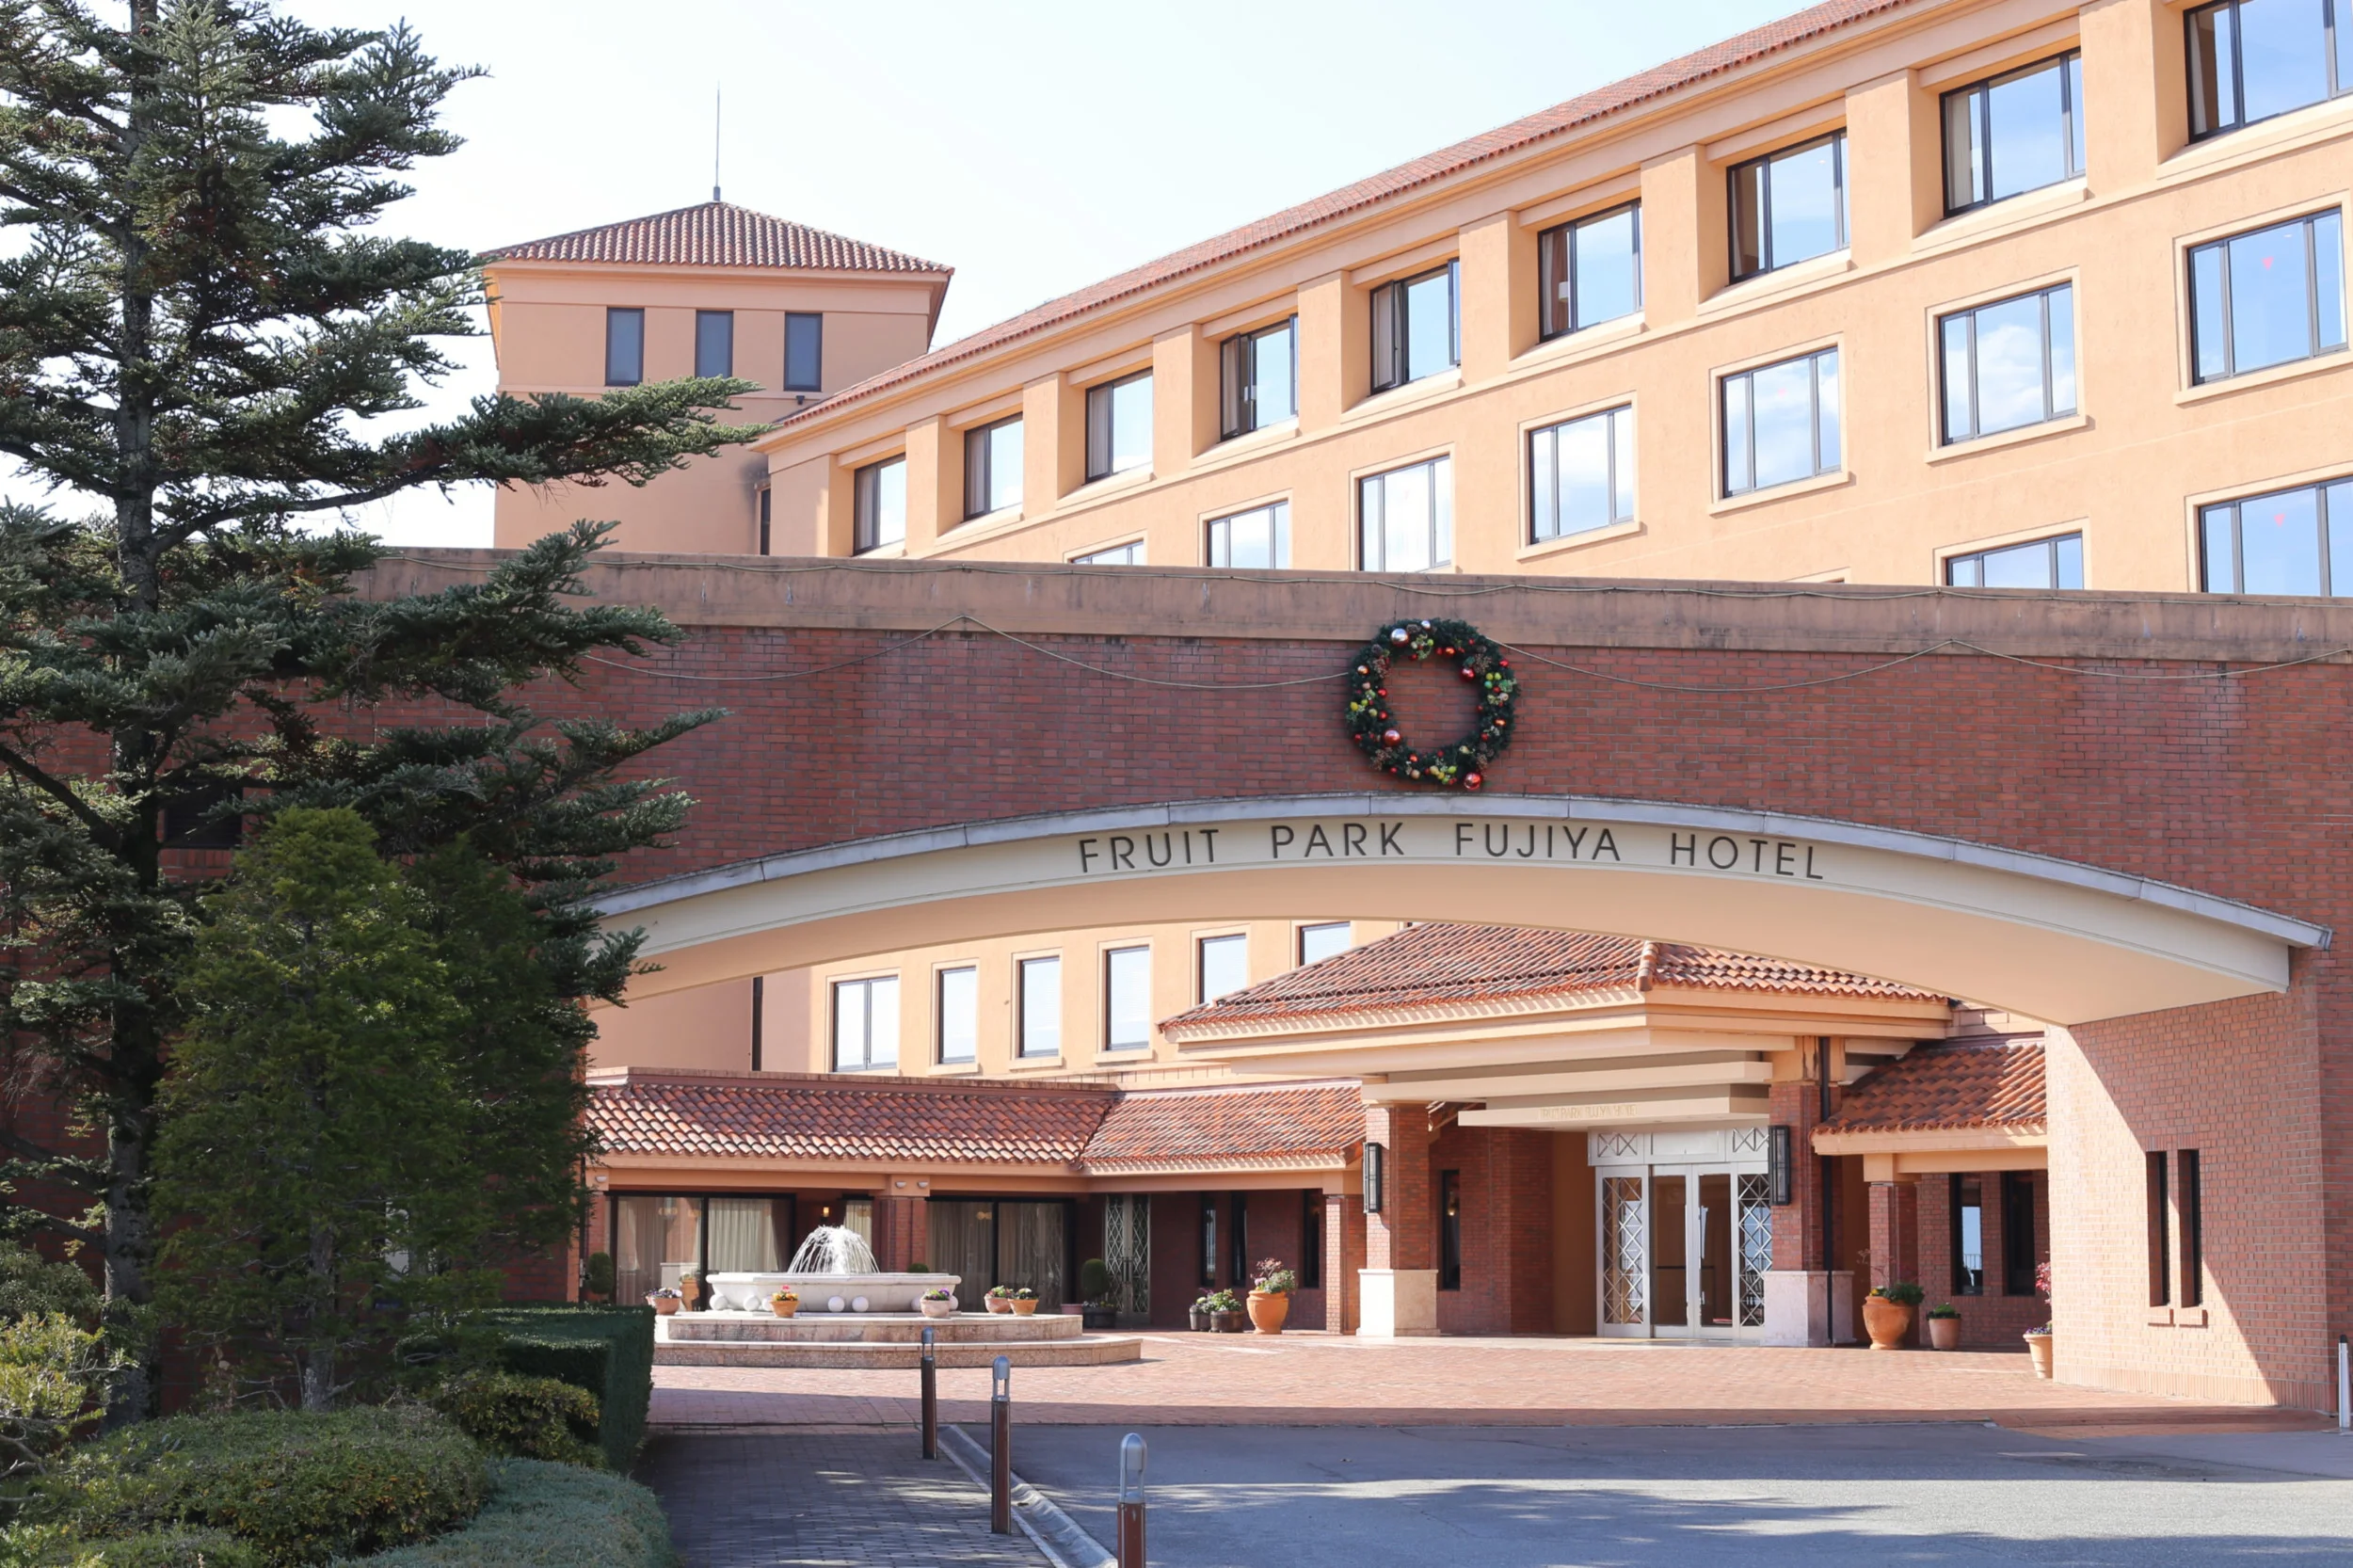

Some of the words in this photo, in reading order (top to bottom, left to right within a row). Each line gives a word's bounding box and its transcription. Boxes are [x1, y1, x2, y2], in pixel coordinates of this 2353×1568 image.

[1080, 828, 1220, 873] FRUIT
[1272, 822, 1404, 859] PARK
[1454, 822, 1621, 861] FUJIYA
[1671, 832, 1824, 880] HOTEL
